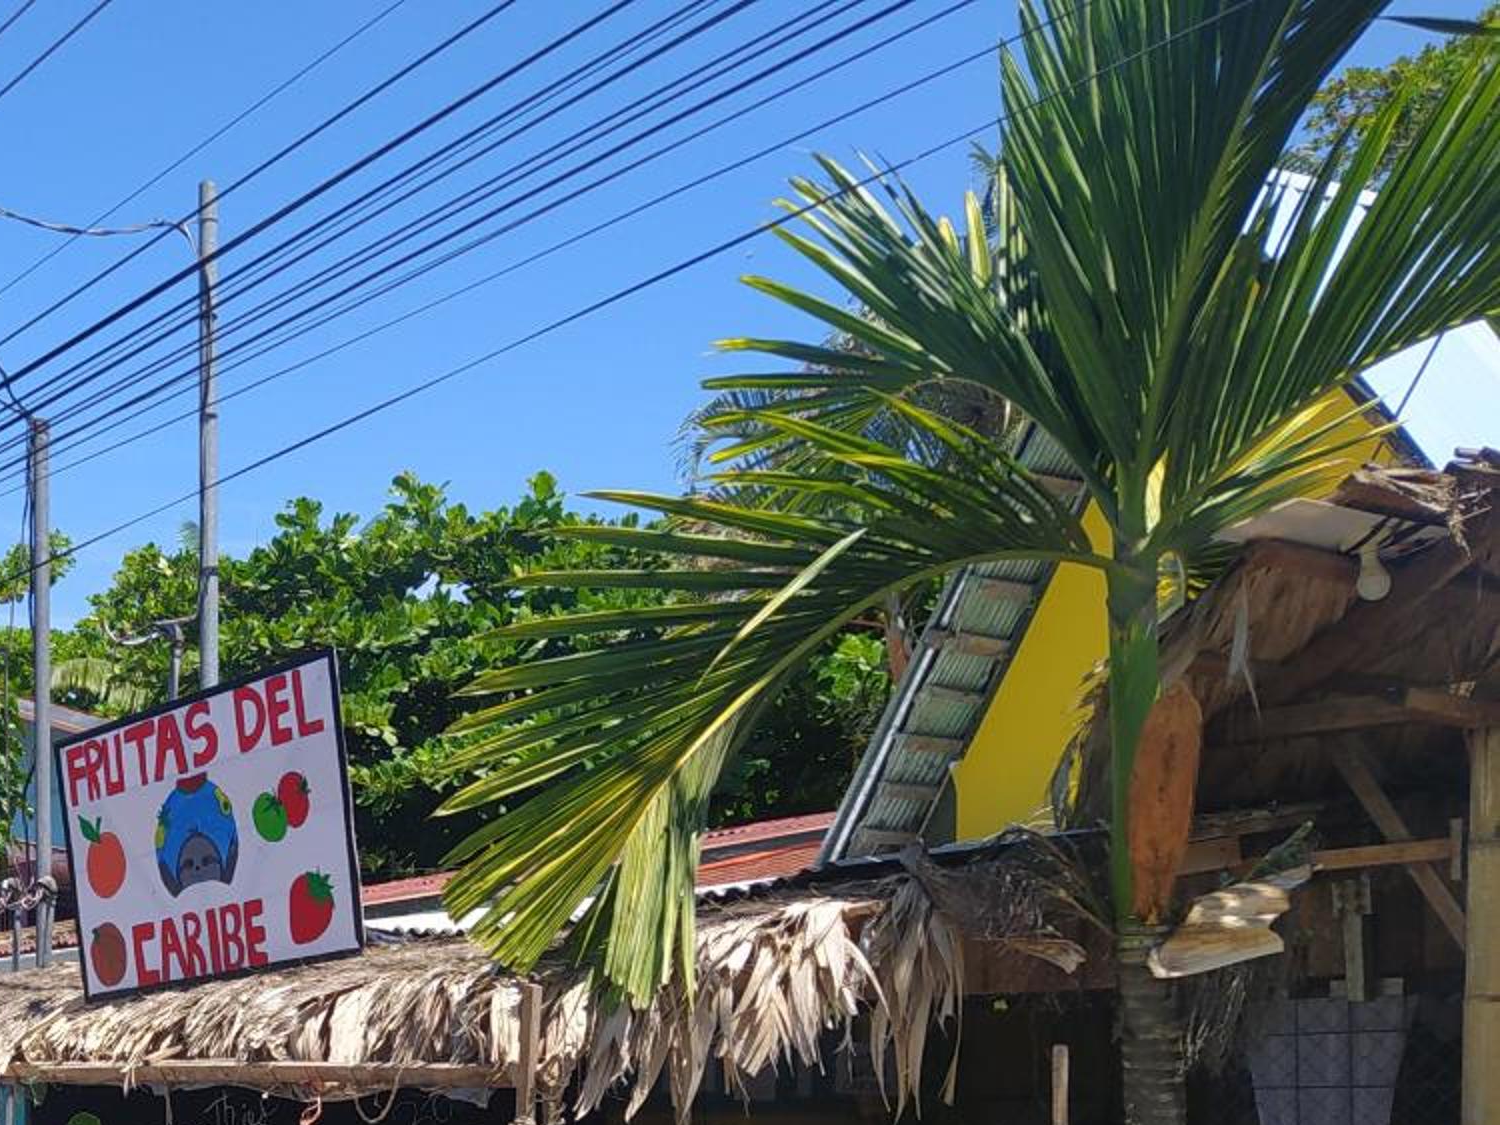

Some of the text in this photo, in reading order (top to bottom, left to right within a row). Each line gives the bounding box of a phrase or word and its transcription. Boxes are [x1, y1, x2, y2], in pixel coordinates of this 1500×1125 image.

[65, 669, 324, 807] FRUTAS DEL
[132, 899, 268, 986] CARIBE
